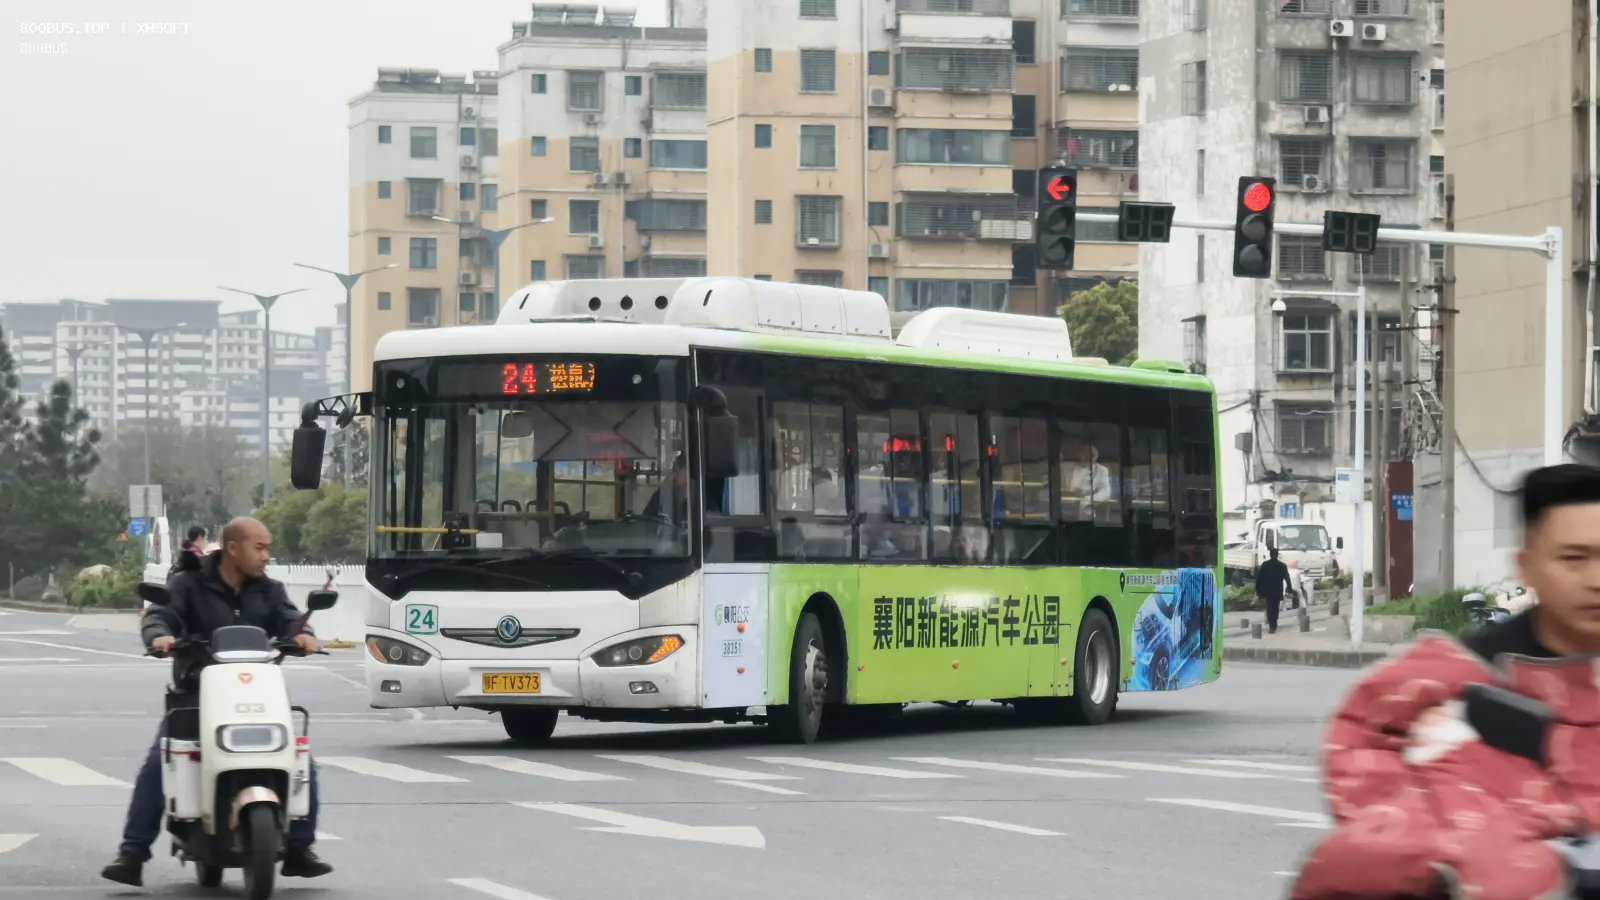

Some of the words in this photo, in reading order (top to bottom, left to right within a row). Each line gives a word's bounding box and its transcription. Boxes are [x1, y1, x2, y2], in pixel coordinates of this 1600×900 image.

[502, 362, 537, 394] 24
[409, 608, 435, 629] 24
[873, 595, 1060, 650] 襄阳新能源汽车公园
